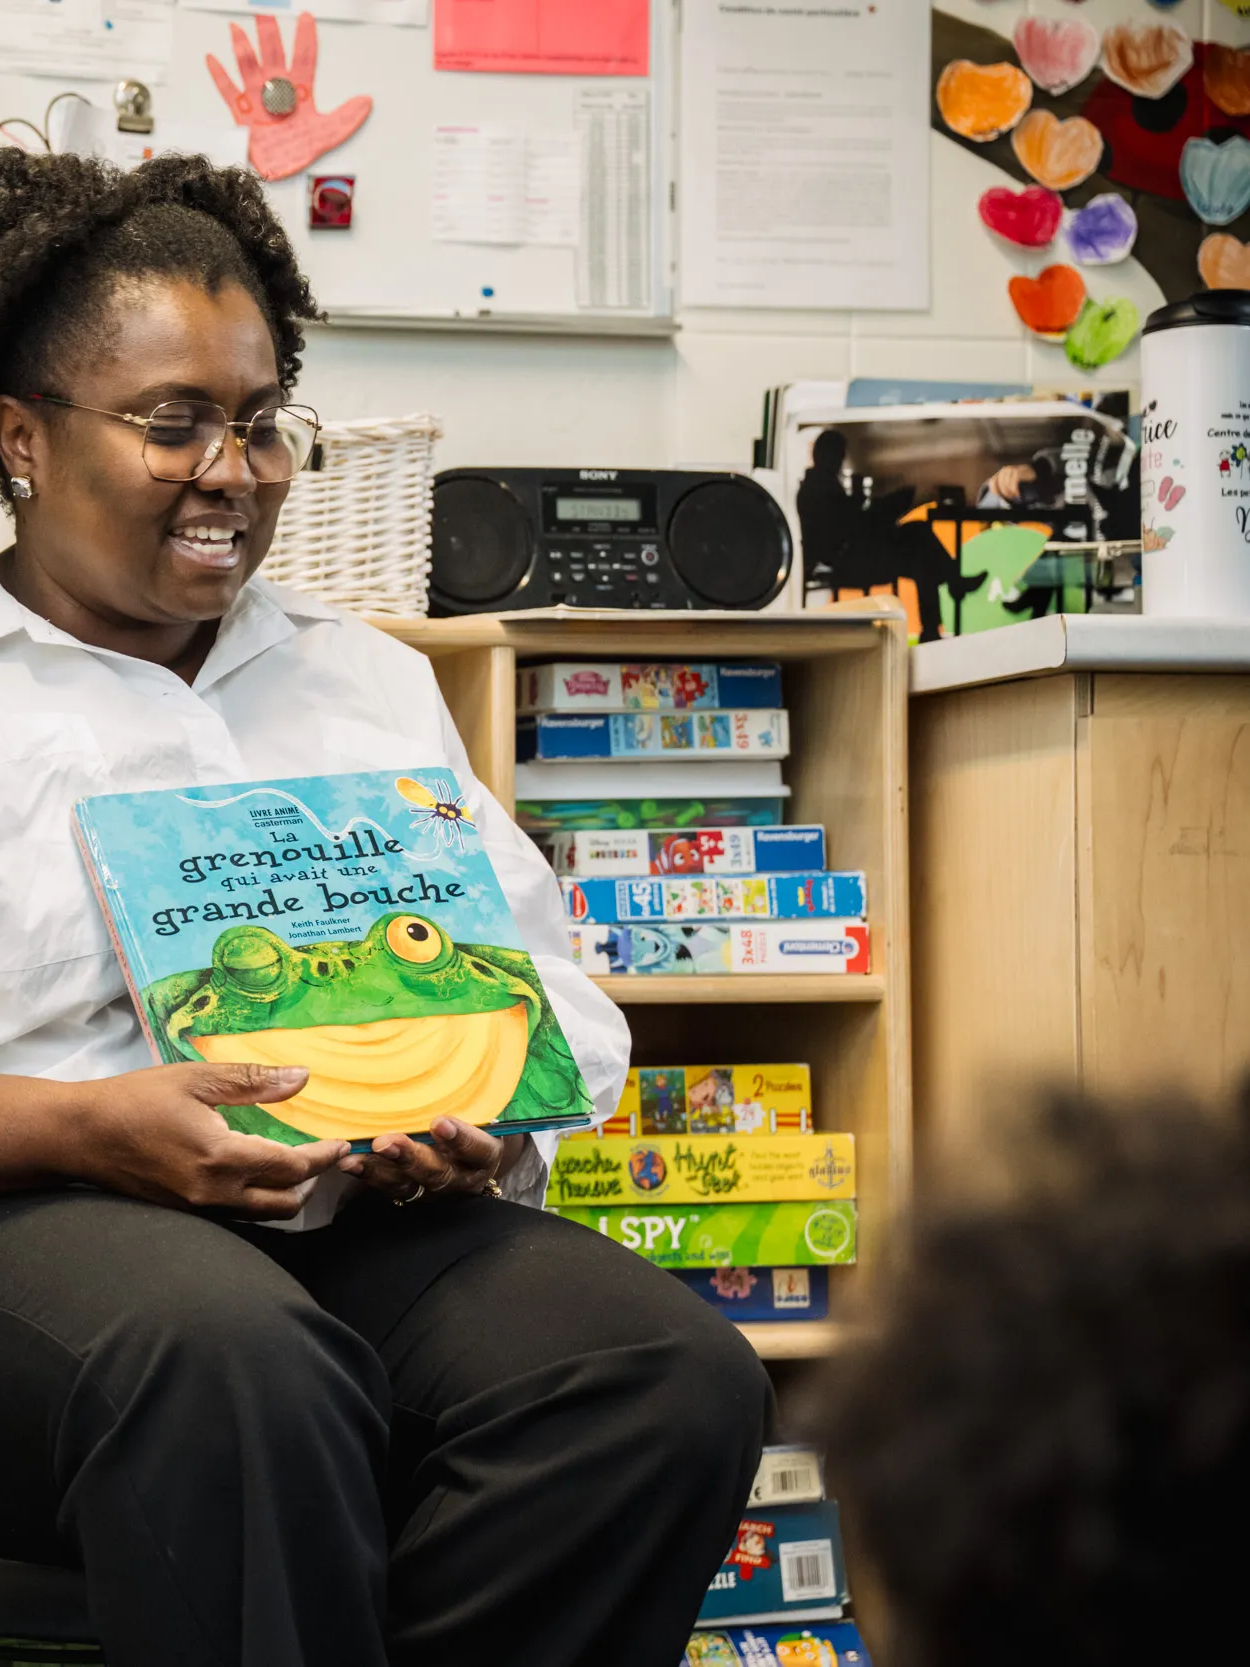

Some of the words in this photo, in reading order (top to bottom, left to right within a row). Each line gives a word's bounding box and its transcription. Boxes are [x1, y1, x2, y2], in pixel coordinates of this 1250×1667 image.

[1207, 428, 1241, 438] Centre
[579, 470, 618, 481] SONY
[1221, 488, 1237, 497] Les
[720, 668, 776, 679] Ravensburger
[541, 717, 605, 729] Ravensburger
[250, 808, 272, 818] LIVRE
[254, 817, 303, 829] casterman
[270, 831, 299, 844] La
[756, 831, 820, 844] Ravensburger
[179, 829, 405, 884] grenouille
[220, 872, 261, 892] qui
[270, 866, 328, 884] avait
[337, 864, 378, 877] une
[152, 888, 304, 936] grande
[317, 873, 466, 912] bouche
[291, 918, 314, 929] Keith
[315, 917, 351, 927] Faulkner
[288, 928, 326, 939] Jonathan
[329, 925, 362, 936] Lambert
[740, 930, 754, 964] 3x48
[753, 1074, 764, 1098] 2
[673, 1141, 737, 1173] Hunt
[620, 1215, 687, 1250] SPY
[735, 1552, 762, 1566] FIND
